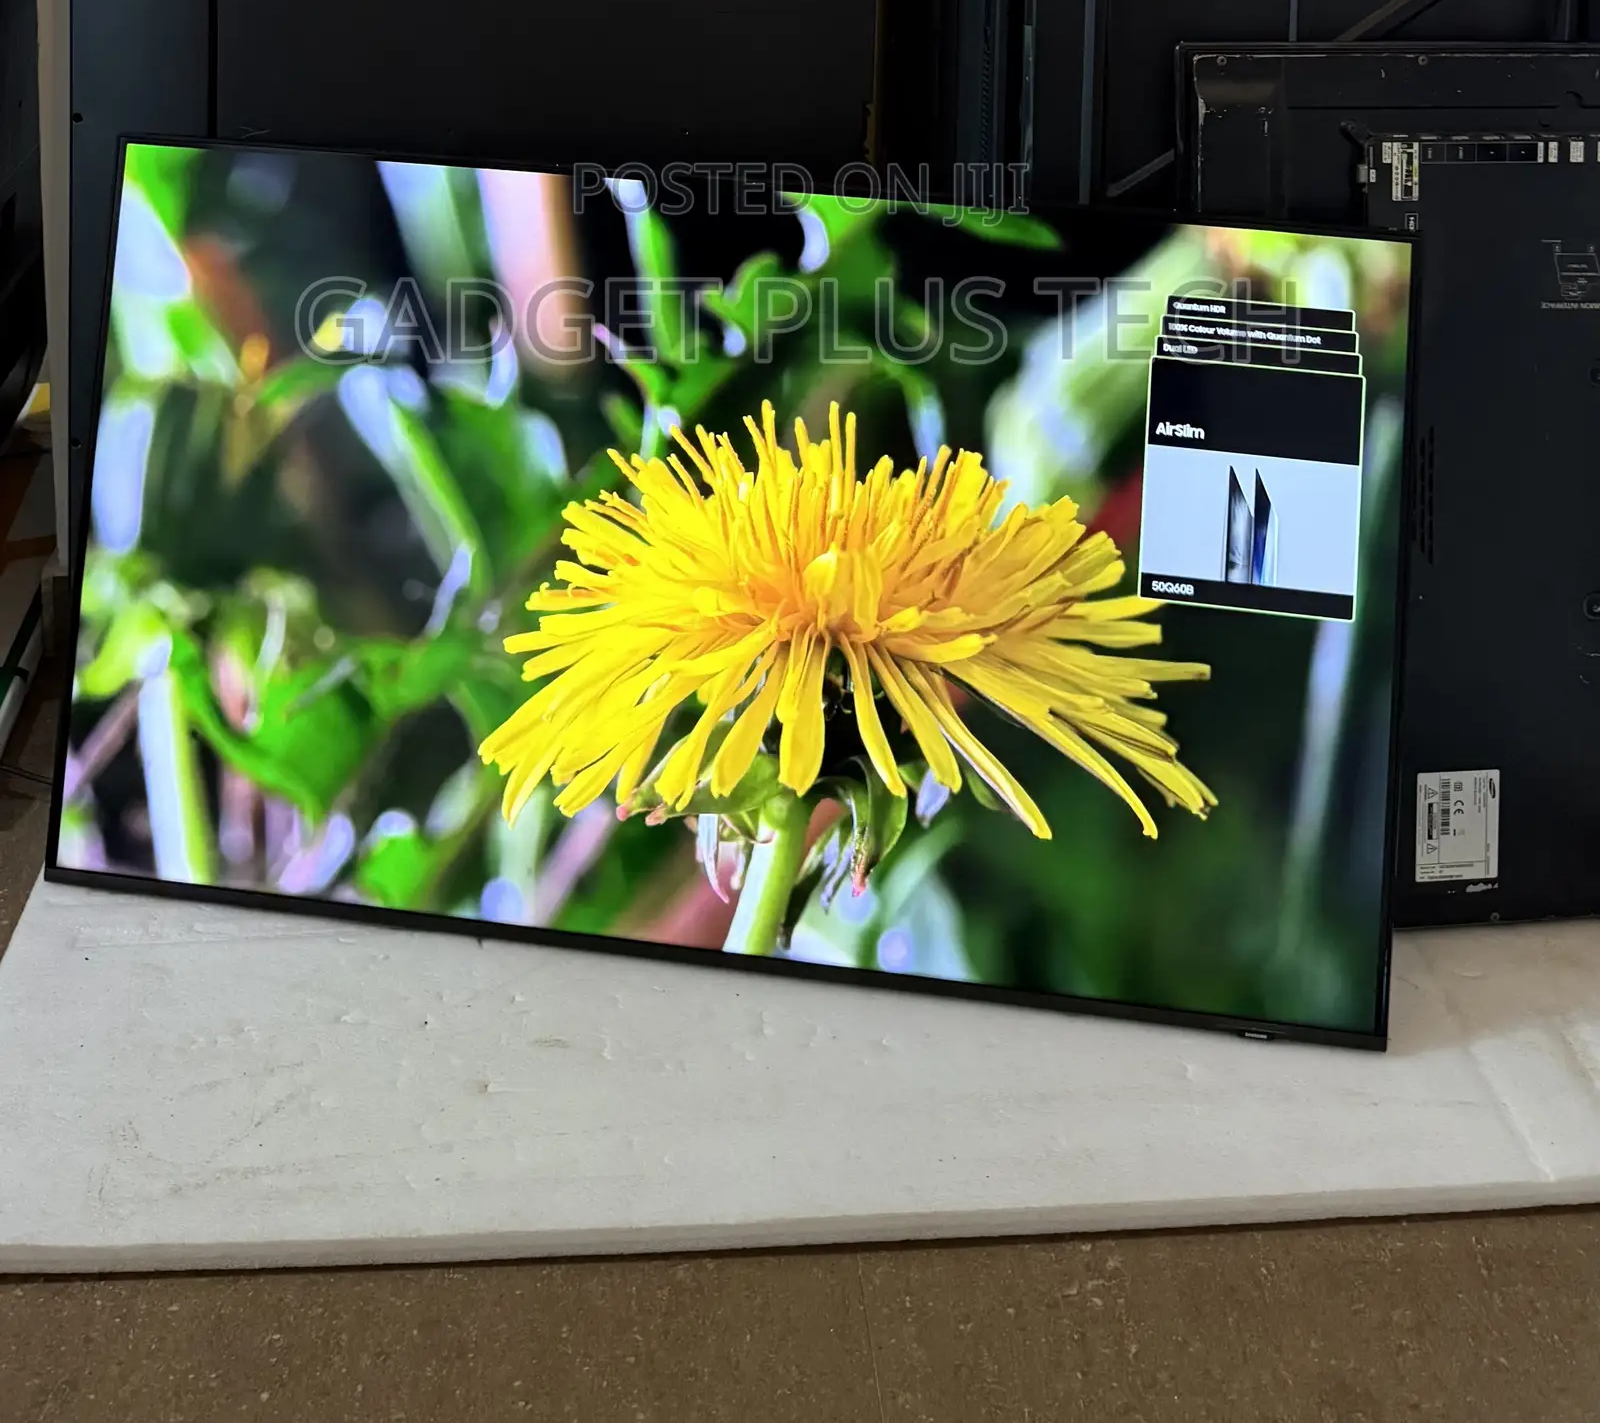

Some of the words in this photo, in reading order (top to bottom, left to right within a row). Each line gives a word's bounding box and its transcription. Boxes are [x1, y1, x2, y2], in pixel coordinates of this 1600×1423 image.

[1173, 301, 1210, 313] Quantum
[1210, 304, 1226, 314] HDR
[1188, 324, 1215, 335] Colour
[1216, 327, 1246, 337] Volume
[1246, 329, 1266, 340] with
[1267, 331, 1305, 343] Quantum
[1306, 335, 1321, 345] Dot
[1162, 343, 1182, 353] Dual
[1182, 345, 1198, 355] LED
[1155, 421, 1205, 440] AirSlim
[1151, 580, 1195, 596] 50Q60B
